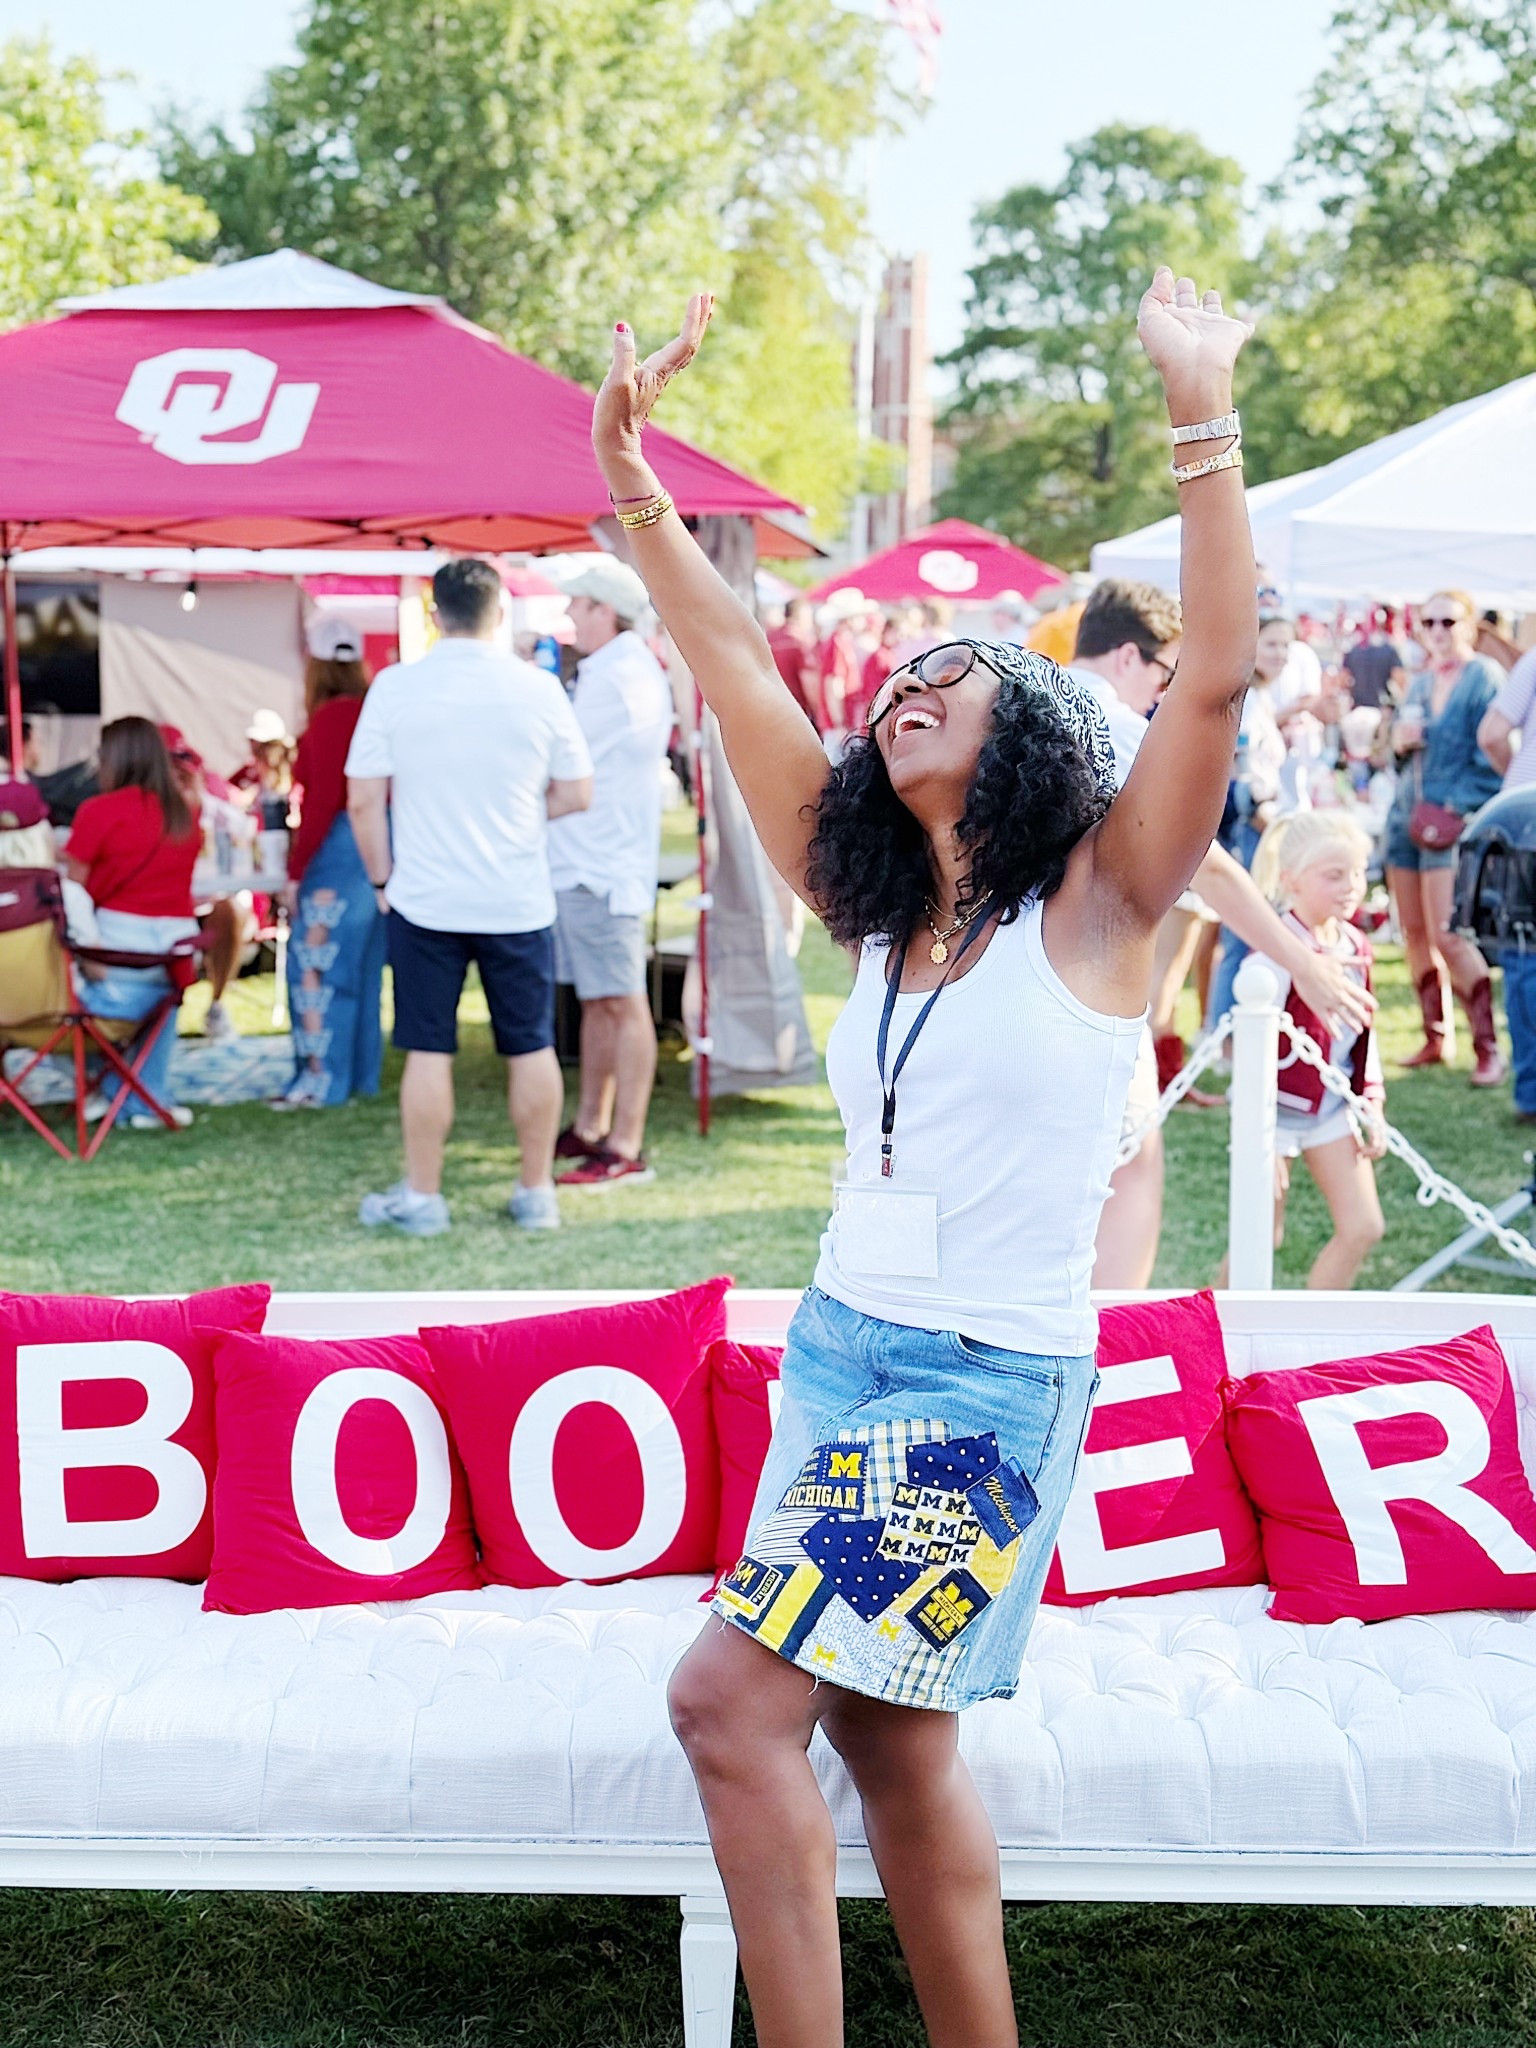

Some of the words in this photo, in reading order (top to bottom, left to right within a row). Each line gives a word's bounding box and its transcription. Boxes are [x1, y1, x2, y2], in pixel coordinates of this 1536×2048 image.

[115, 347, 321, 465] OU
[828, 1452, 863, 1479] M
[895, 1487, 918, 1506] M
[921, 1492, 943, 1510] M
[945, 1497, 967, 1515] M
[984, 1475, 1019, 1534] Michigan
[889, 1511, 910, 1530] M
[913, 1517, 935, 1535] M
[937, 1521, 957, 1538] M
[960, 1524, 979, 1541] M
[881, 1537, 903, 1554] M
[904, 1542, 926, 1558] M
[926, 1545, 949, 1561] M
[950, 1548, 970, 1563] M
[937, 1594, 962, 1622] MICHIGAN
